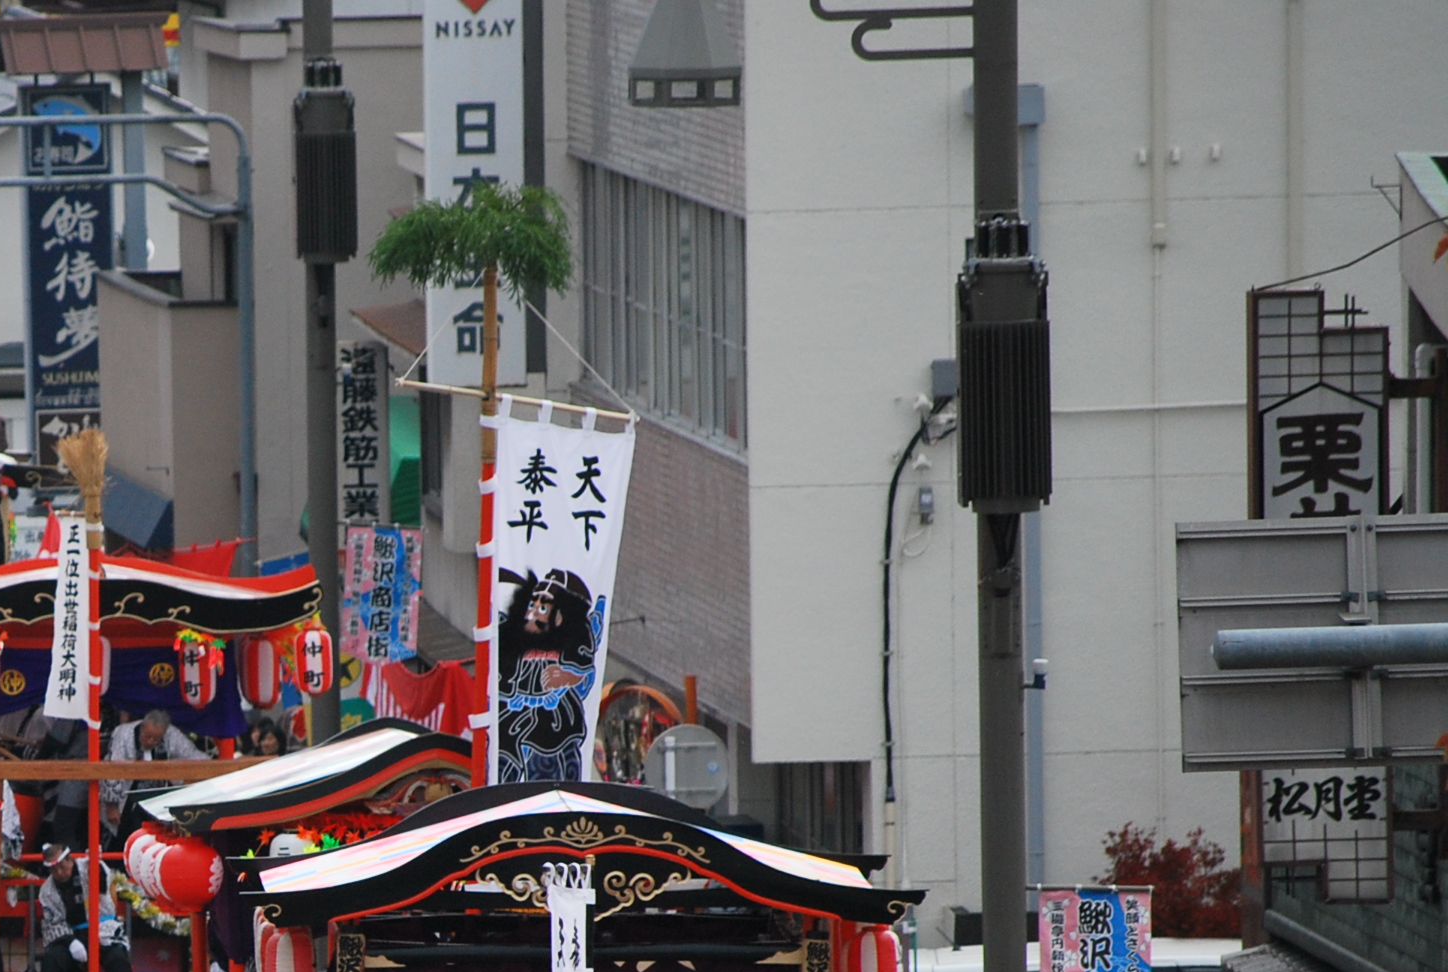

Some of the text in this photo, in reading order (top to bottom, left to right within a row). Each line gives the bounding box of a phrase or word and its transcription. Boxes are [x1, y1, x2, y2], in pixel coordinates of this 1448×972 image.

[435, 19, 516, 38] NISSAY
[507, 448, 558, 543] 泰平
[571, 456, 606, 551] 天下
[58, 524, 82, 702] 正一位出世稲荷大明神
[302, 641, 324, 688] 仲町
[1266, 775, 1381, 822] 松月堂
